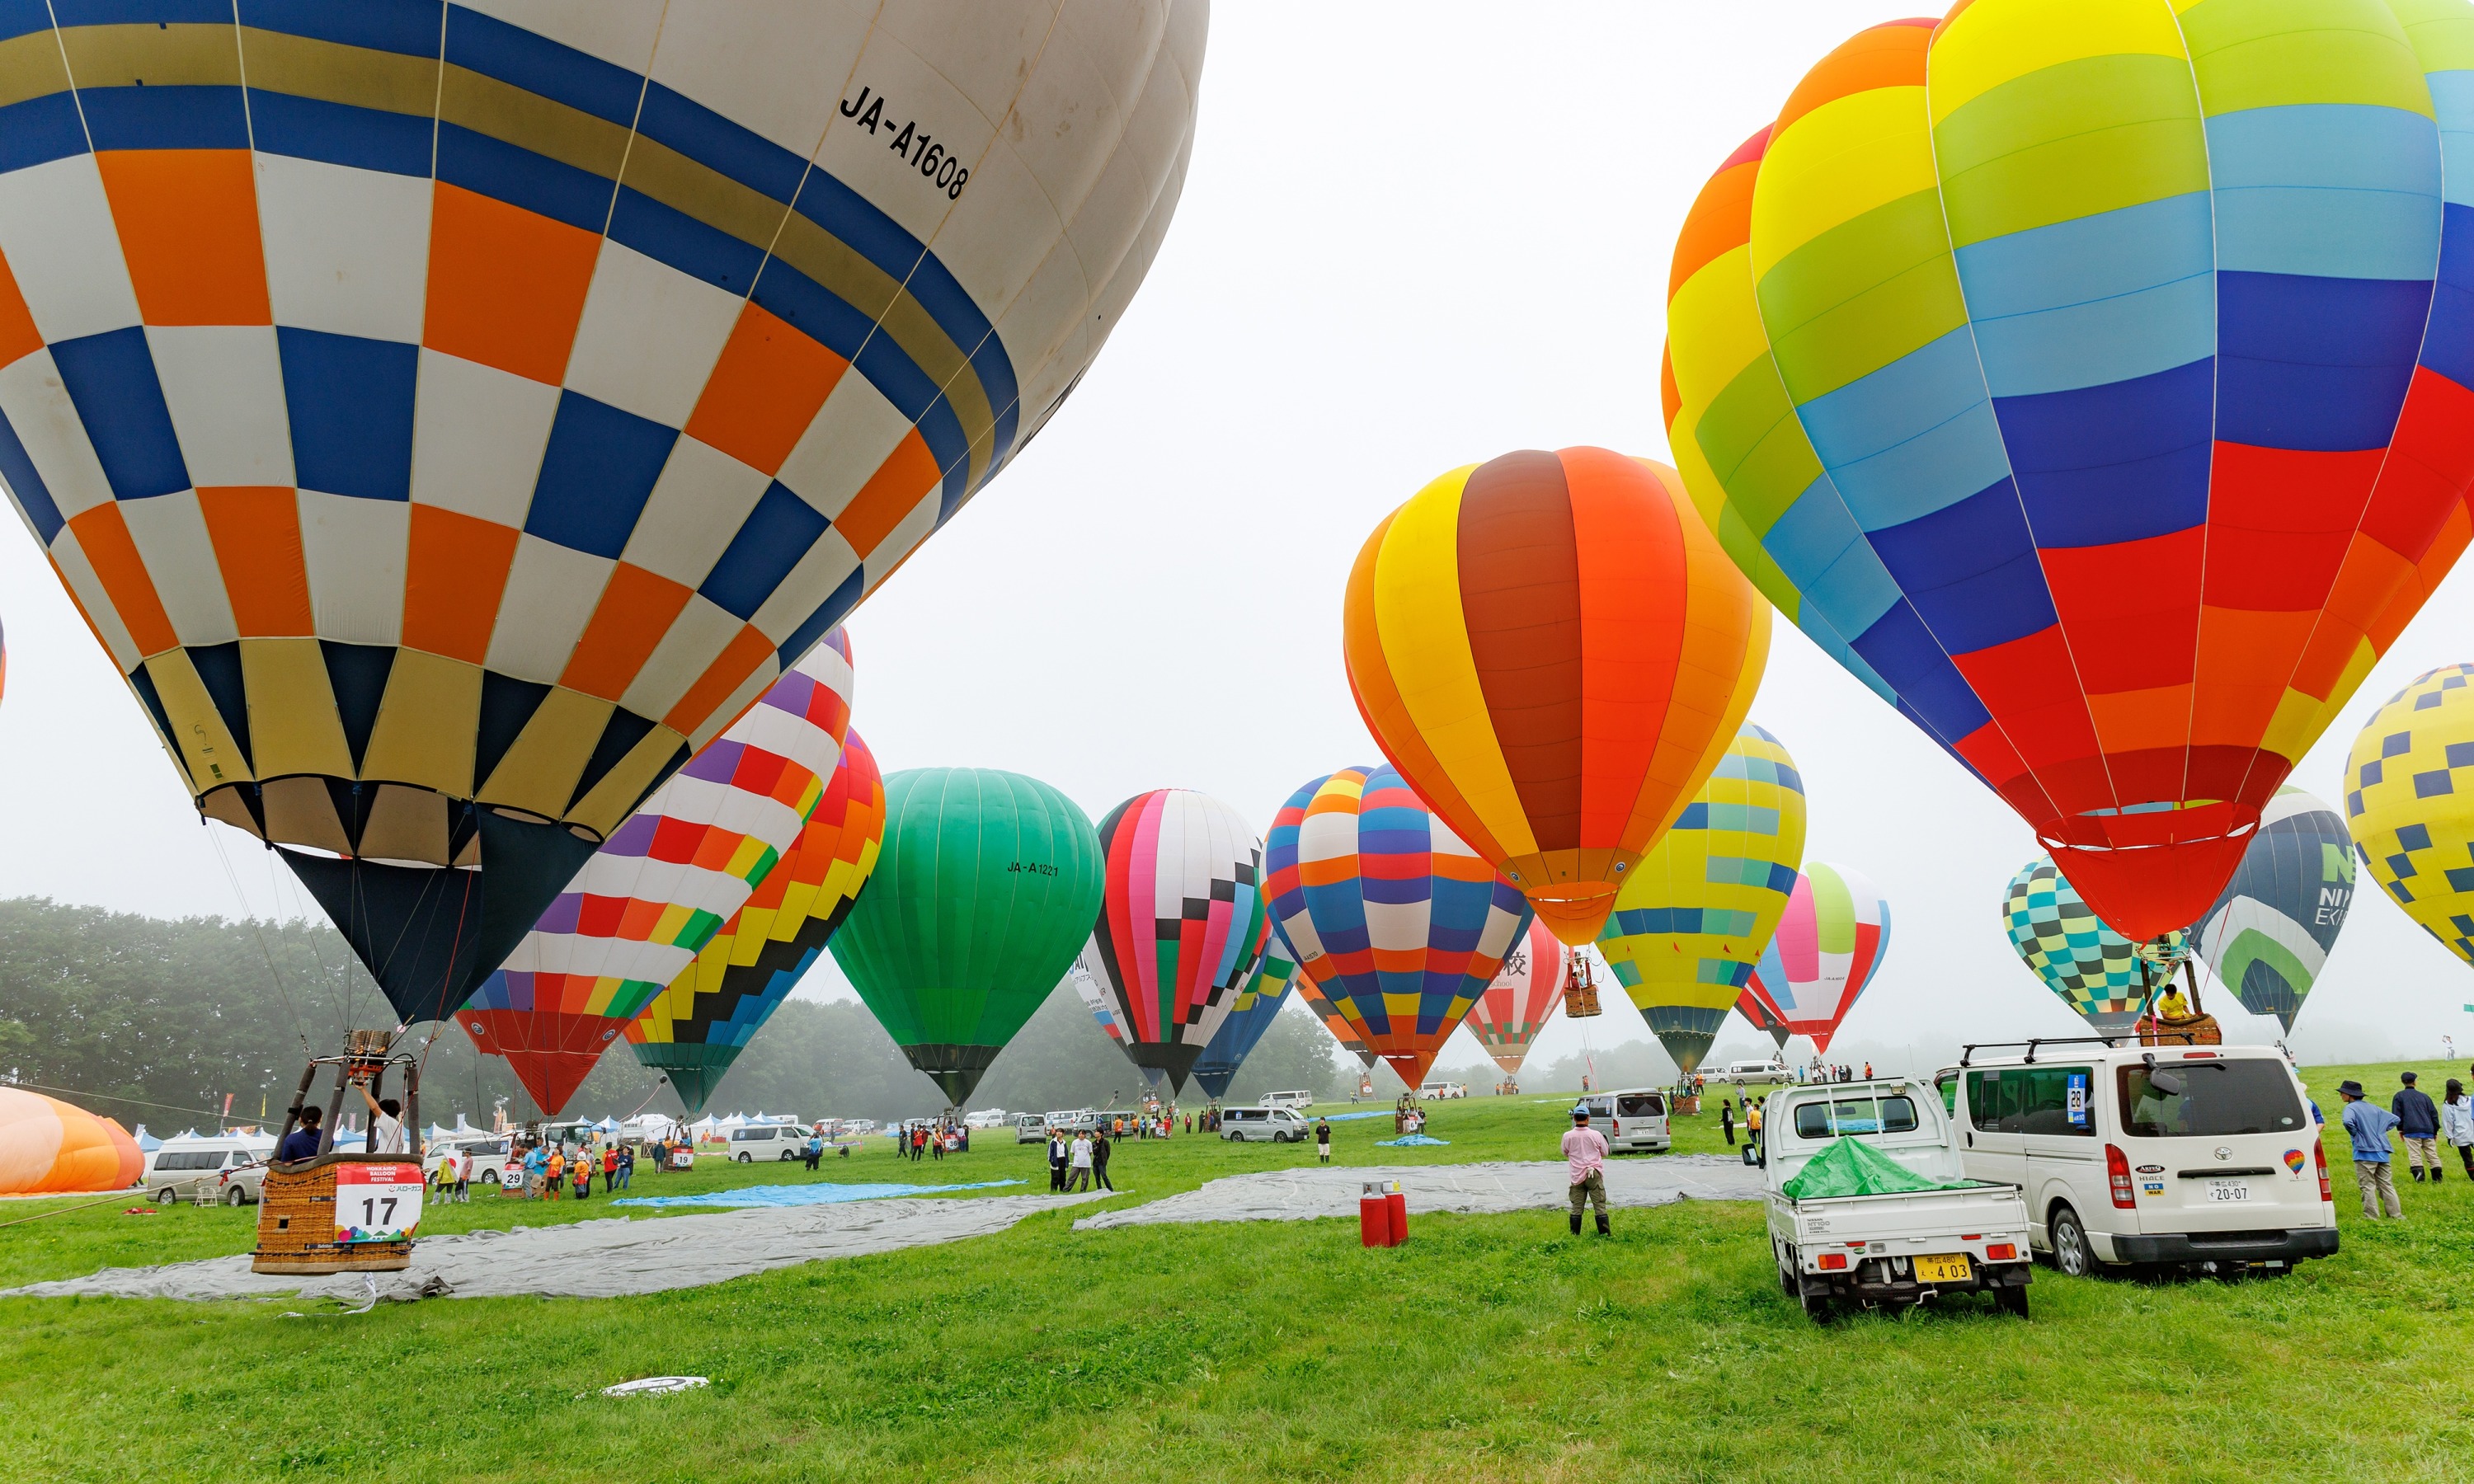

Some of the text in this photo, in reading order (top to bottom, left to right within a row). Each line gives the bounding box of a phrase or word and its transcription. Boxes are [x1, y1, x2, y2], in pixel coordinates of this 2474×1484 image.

[840, 86, 969, 200] JA-A1608
[1490, 979, 1512, 988] school
[2071, 1090, 2081, 1108] 28
[506, 1173, 521, 1184] 29
[2215, 1187, 2247, 1200] 20-07
[362, 1197, 398, 1226] 17
[1942, 1256, 1956, 1264] 480
